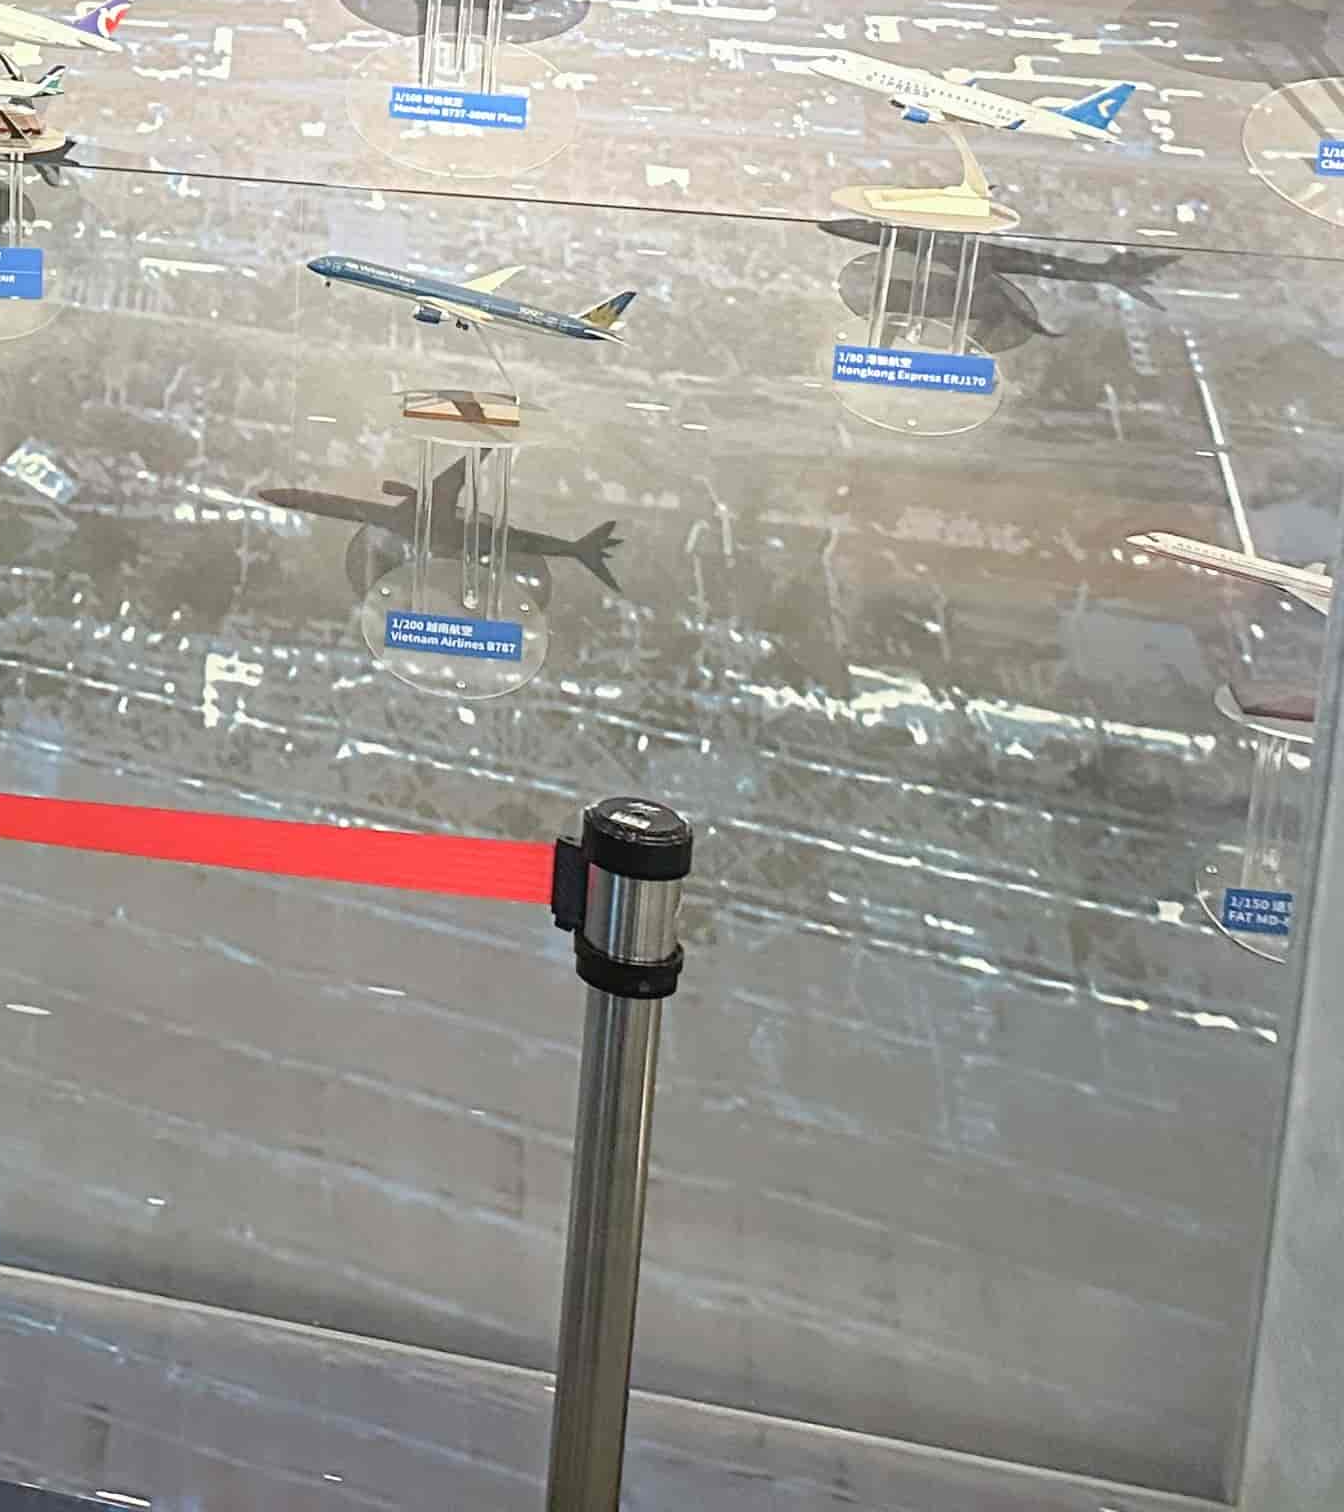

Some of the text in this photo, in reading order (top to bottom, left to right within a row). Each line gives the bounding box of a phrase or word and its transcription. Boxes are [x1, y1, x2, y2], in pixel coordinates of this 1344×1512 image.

[837, 364, 987, 388] Hongkong Express ERJ170
[391, 617, 425, 631] 1/200
[390, 631, 439, 646] Vietnam
[440, 636, 485, 651] Airlines
[1228, 909, 1254, 924] FAT
